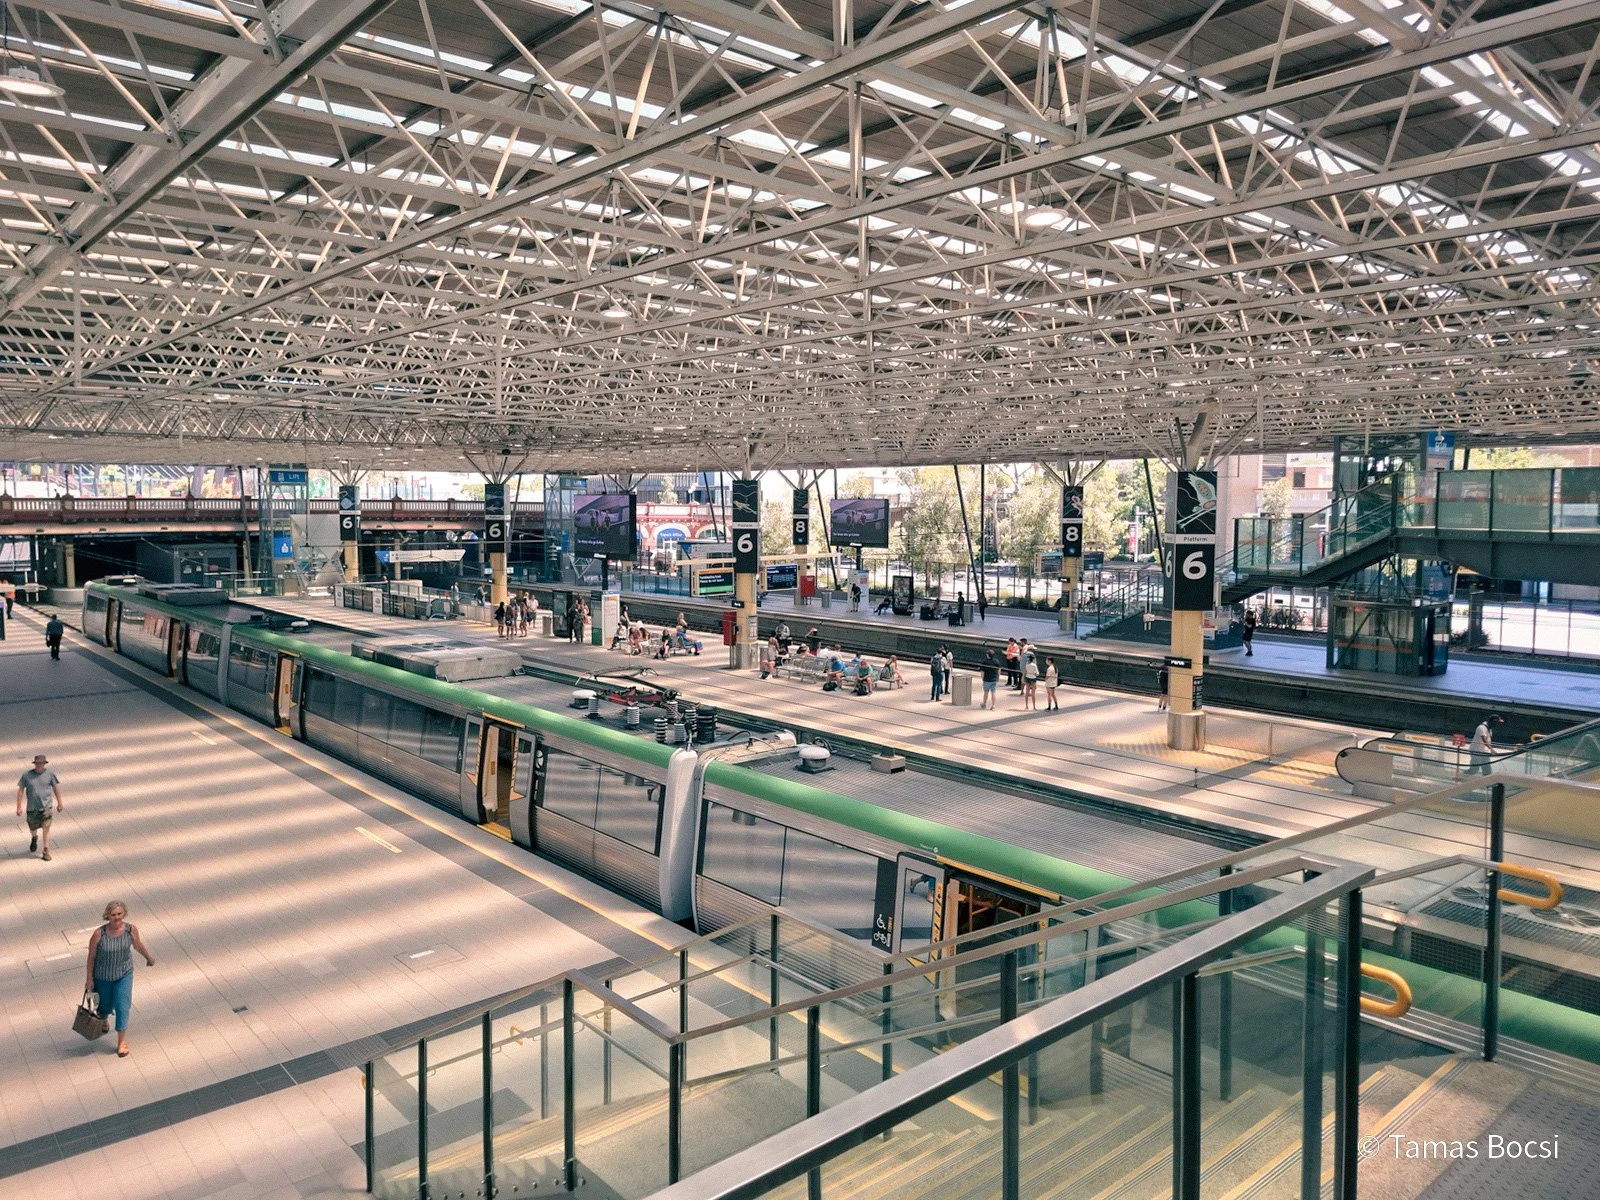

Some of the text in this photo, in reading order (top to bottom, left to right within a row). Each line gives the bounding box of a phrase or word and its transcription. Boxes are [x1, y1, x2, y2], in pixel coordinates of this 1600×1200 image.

[343, 516, 353, 529] 6
[489, 522, 502, 538] 6
[795, 520, 806, 534] 8
[1065, 526, 1079, 542] 8
[736, 532, 754, 554] 6
[1165, 550, 1173, 578] 6
[1182, 550, 1207, 580] 6
